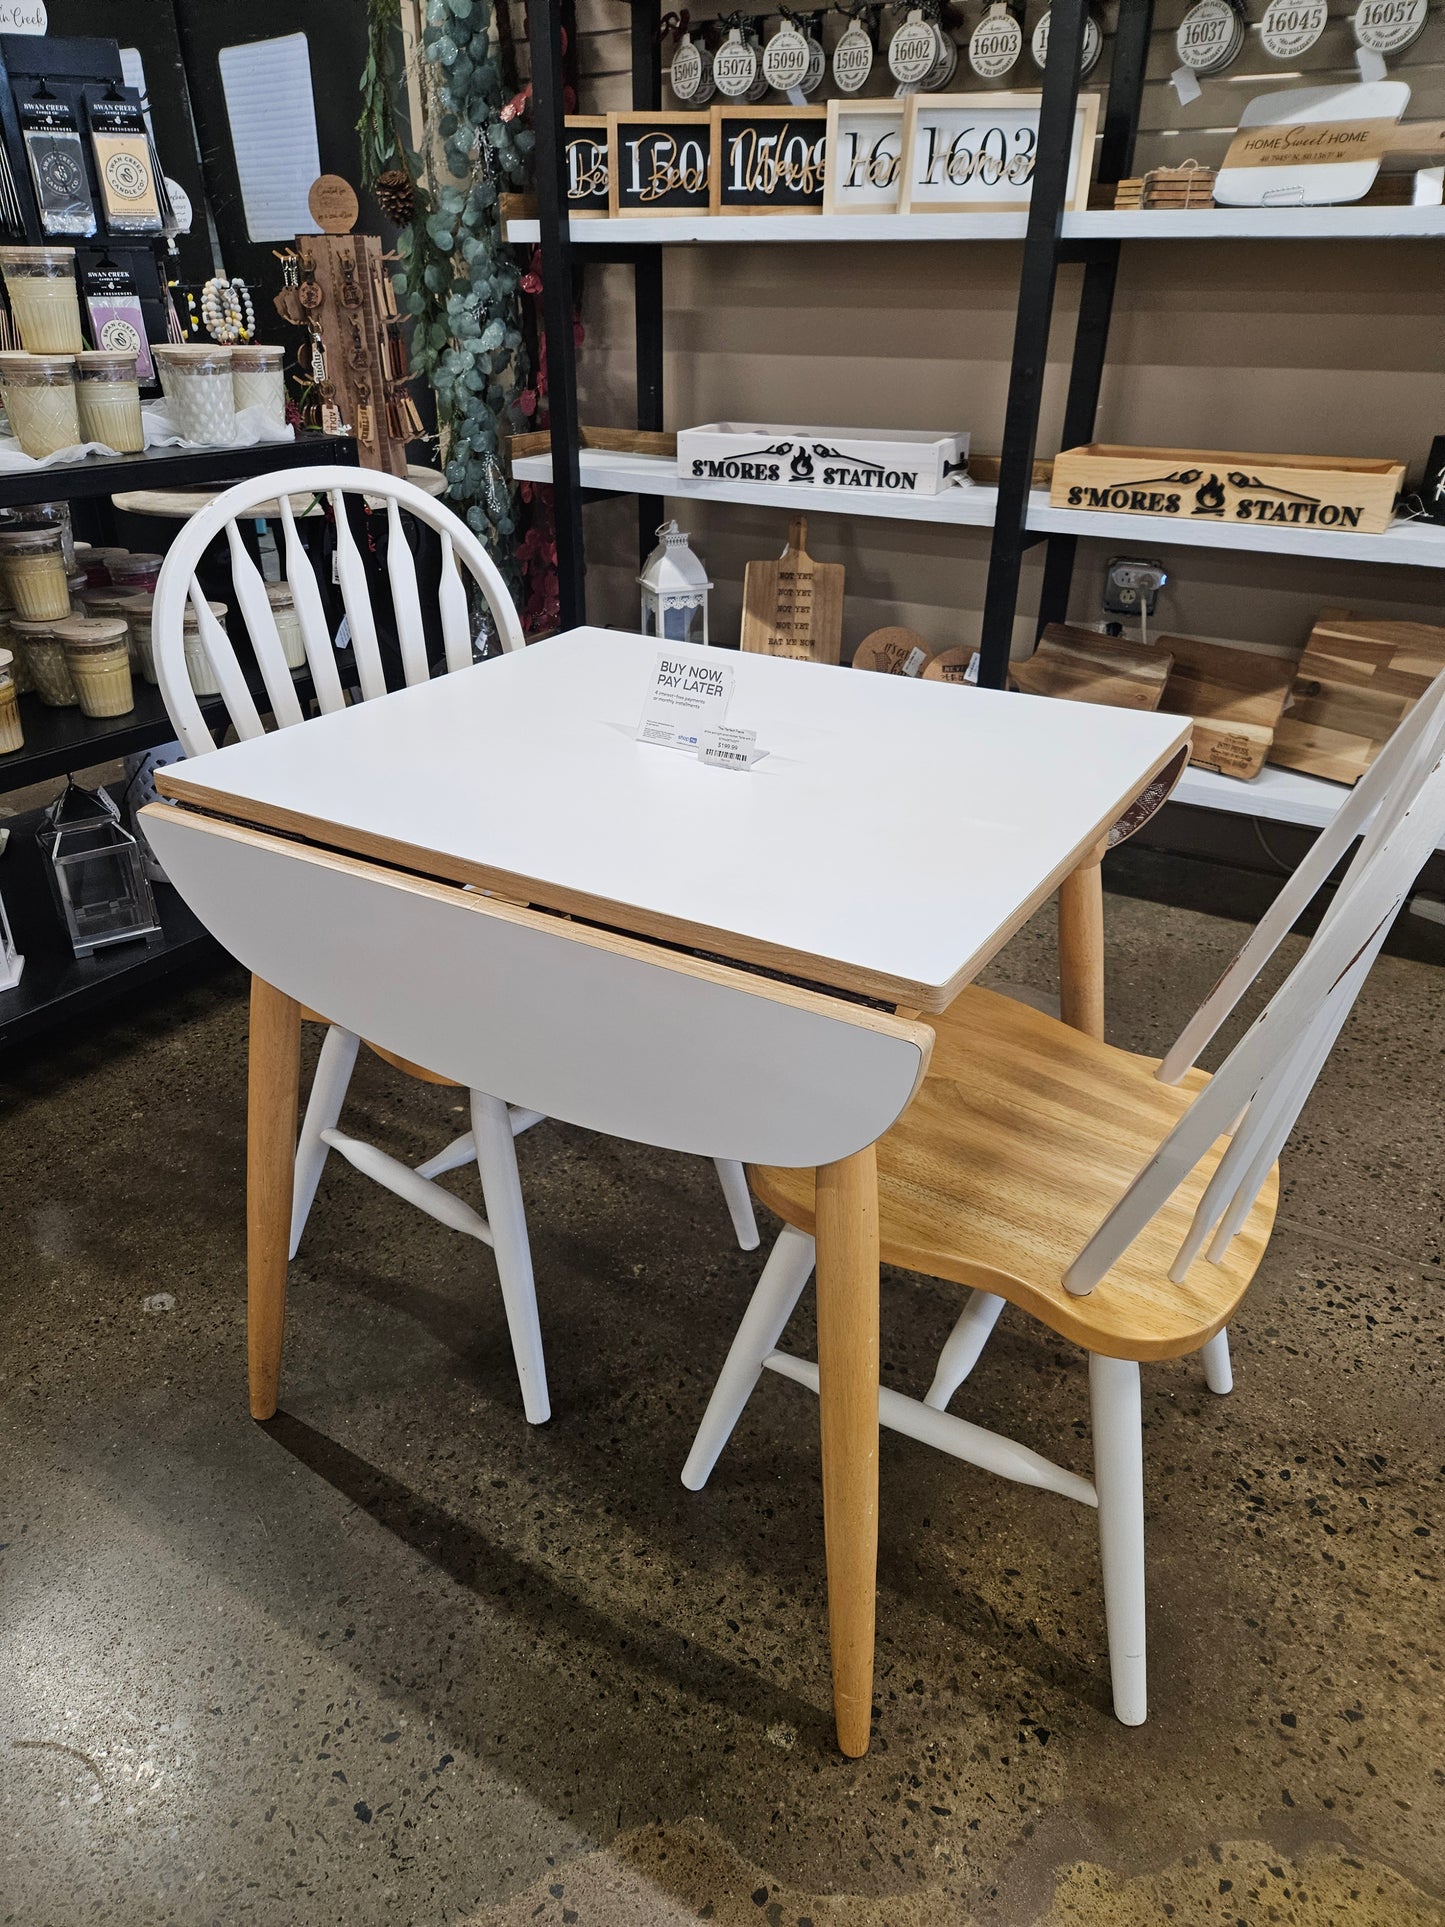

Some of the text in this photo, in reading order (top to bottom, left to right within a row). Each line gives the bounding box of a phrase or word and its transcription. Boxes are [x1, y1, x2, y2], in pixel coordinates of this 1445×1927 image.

[1266, 8, 1323, 33] 16045
[1362, 1, 1418, 26] 16057
[1184, 20, 1227, 45] 16037
[894, 40, 930, 61] 16002
[974, 34, 1018, 56] 16003
[717, 59, 752, 76] 15074
[768, 50, 804, 69] 15090
[837, 50, 869, 69] 15005
[674, 60, 699, 81] 15009
[45, 104, 70, 112] CREEK
[114, 104, 138, 112] CREEK
[1245, 126, 1371, 150] HOME Sweet HOME
[109, 157, 144, 173] SWAN CREEK
[918, 126, 1036, 186] 1603
[692, 459, 919, 490] S'MORES STATION
[1067, 486, 1365, 527] S'MORES STATION
[779, 572, 814, 580] NOT YET
[778, 589, 812, 597] NOT YET
[777, 605, 793, 613] NOT
[775, 622, 810, 630] NOT YET
[768, 638, 816, 648] EAT ME NOW
[660, 661, 723, 684] BUY NOW,
[657, 674, 724, 697] PAY LATER
